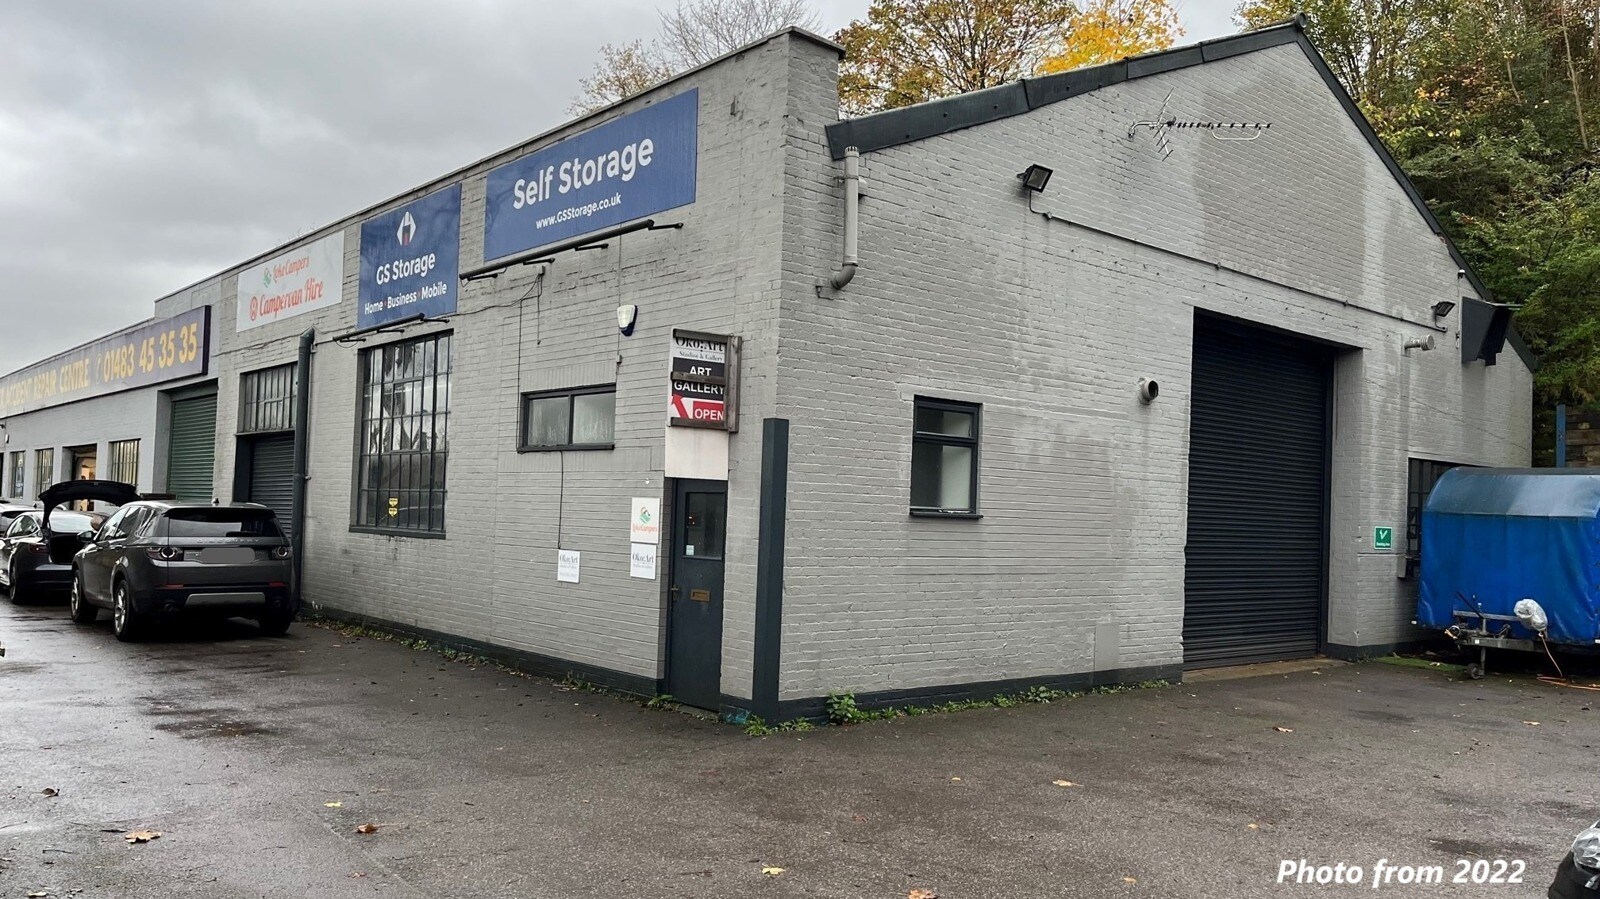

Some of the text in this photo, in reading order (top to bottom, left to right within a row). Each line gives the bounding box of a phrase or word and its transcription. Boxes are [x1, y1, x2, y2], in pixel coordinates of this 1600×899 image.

[513, 138, 654, 210] Self Storage
[535, 192, 622, 230] www.GSStorage.co.uk
[376, 253, 436, 285] GS Storage
[259, 277, 324, 318] Campervan Hire
[364, 281, 448, 315] Home Business Mobile
[34, 369, 57, 400] REPAIR
[60, 358, 90, 393] CENTRE
[103, 343, 135, 383] 01483
[139, 337, 155, 373] 45
[158, 330, 175, 369] 35
[179, 323, 198, 364] 35
[689, 366, 712, 376] ART
[674, 381, 724, 395] GALLERY
[694, 408, 724, 420] OPEN
